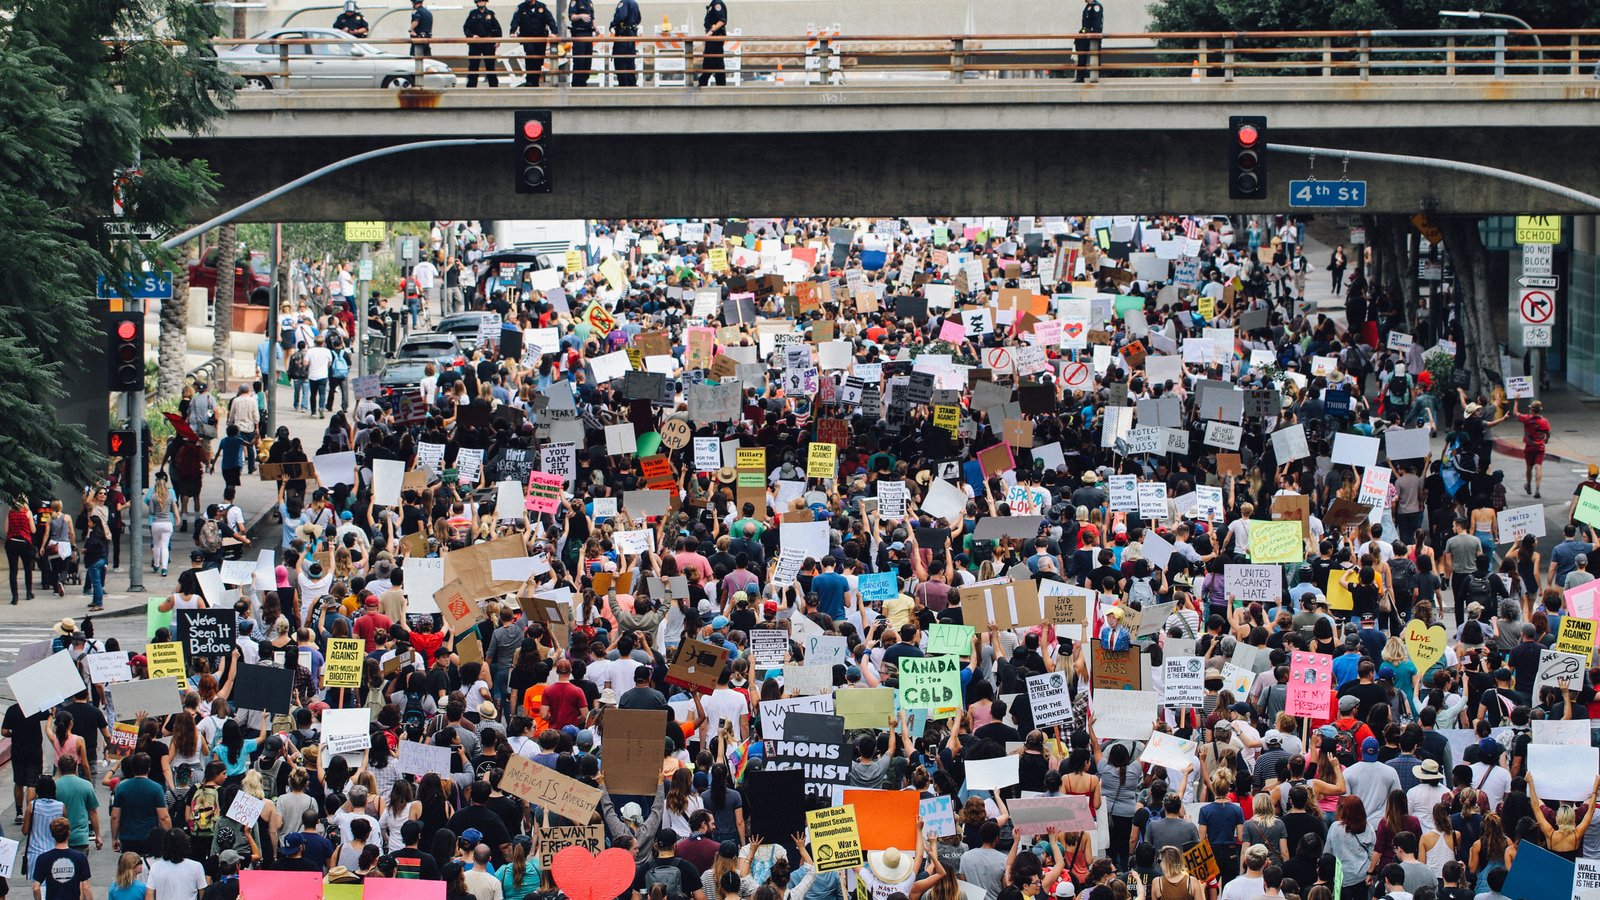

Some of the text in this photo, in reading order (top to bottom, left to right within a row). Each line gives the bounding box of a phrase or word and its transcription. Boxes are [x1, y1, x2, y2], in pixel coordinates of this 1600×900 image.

[1296, 186, 1359, 202] 4th St
[345, 230, 383, 240] SCHOOL
[1519, 230, 1557, 241] SCHOOL
[1526, 245, 1551, 254] DO NOT
[1525, 256, 1551, 266] BLOCK
[144, 279, 165, 292] St
[1326, 401, 1348, 409] THINK
[540, 409, 577, 418] 4 YEARS
[667, 422, 687, 435] NO
[1127, 427, 1159, 437] PROTECT
[661, 431, 685, 449] DAPL
[813, 444, 832, 452] STAND
[1127, 441, 1158, 452] PUSSY
[545, 455, 571, 463] CAN'T
[738, 451, 764, 459] Hillary
[811, 451, 833, 459] AGAINST
[643, 460, 664, 468] TRUMP
[1365, 469, 1390, 484] LOVE
[1360, 495, 1383, 508] HATE
[1507, 513, 1530, 522] UNITED
[1512, 528, 1527, 536] HATE
[1239, 568, 1271, 578] UNITED
[1233, 578, 1272, 588] AGAINST
[1242, 589, 1267, 599] HATE
[1057, 596, 1071, 605] END
[1054, 604, 1074, 612] HATE
[184, 612, 217, 627] We've
[189, 623, 232, 639] Seen It
[1566, 619, 1592, 632] STAND
[933, 626, 975, 649] ALLY
[1562, 628, 1592, 641] AGAINST
[190, 638, 232, 654] Before
[333, 641, 358, 651] STAND
[1557, 641, 1593, 653] ANTI-MUSLIM
[330, 650, 359, 661] AGAINST
[1541, 652, 1560, 664] SAFE
[326, 664, 361, 673] ANTI-MUSLIM
[901, 658, 957, 674] CANADA
[1104, 662, 1127, 675] ASS
[1167, 660, 1182, 668] WALL
[1166, 666, 1186, 674] STREET
[328, 672, 358, 681] BIGOTRY!
[915, 675, 942, 685] is too
[1557, 672, 1580, 682] PLACE
[1028, 679, 1045, 687] WALL
[1030, 684, 1050, 694] STREET
[904, 686, 953, 704] COLD
[1031, 691, 1046, 700] IS THE
[1293, 690, 1326, 701] NOT MY
[1033, 701, 1062, 712] FOR THE
[1035, 708, 1070, 721] WORKERS
[112, 730, 138, 741] DONALD
[402, 742, 440, 758] ANGRY
[776, 740, 840, 760] MOMS
[764, 760, 850, 781] AGAINST
[506, 767, 596, 812] AMERICA IS DIVERSITY
[815, 807, 846, 820] Fight Back
[810, 818, 832, 830] Against
[540, 826, 599, 840] WE WANT
[837, 840, 859, 850] War &
[834, 849, 860, 860] Racism
[1184, 843, 1214, 869] HELL
[1577, 863, 1597, 873] WALL
[1575, 880, 1594, 889] IS THE
